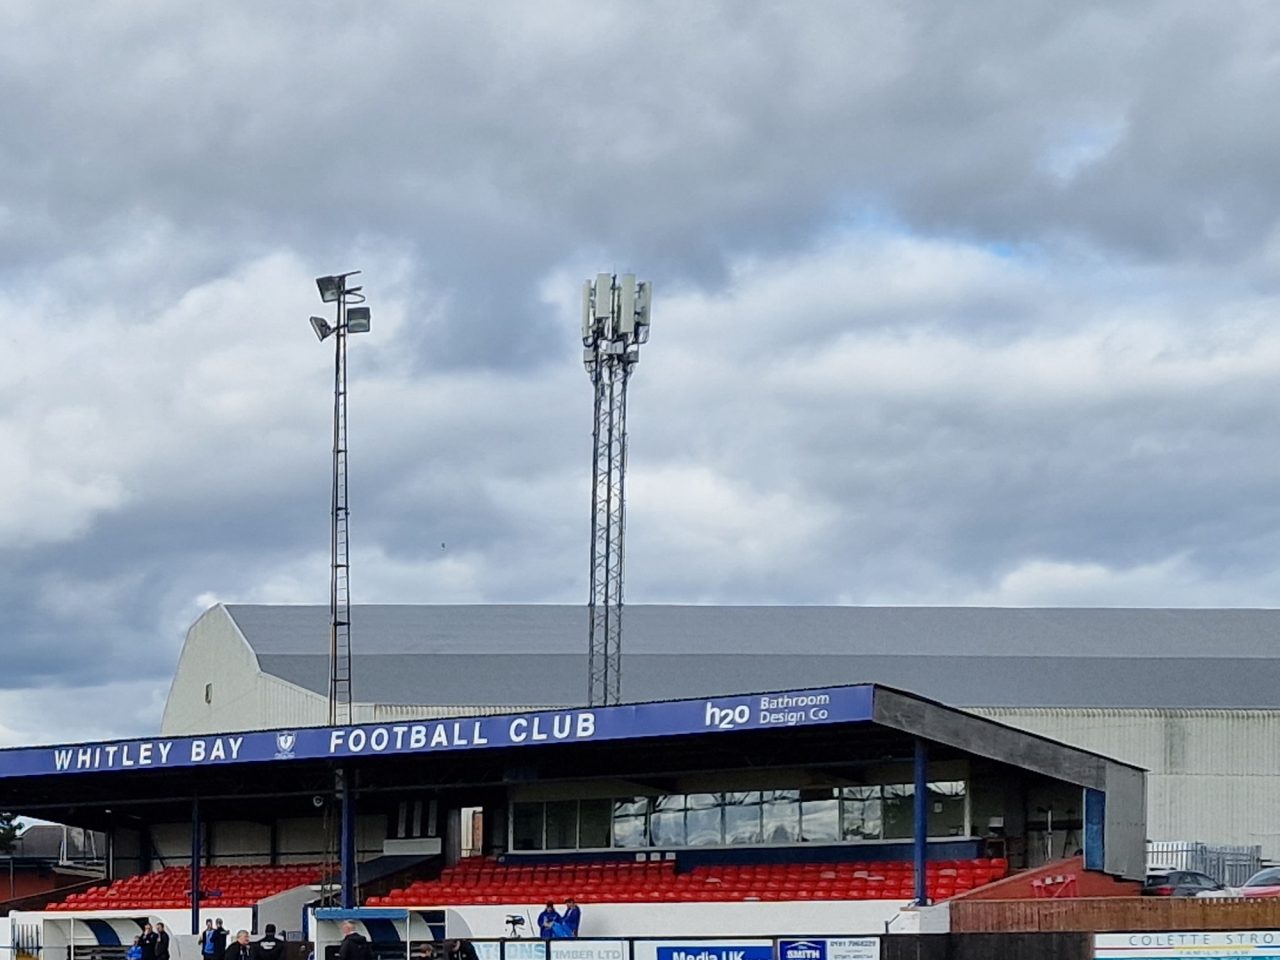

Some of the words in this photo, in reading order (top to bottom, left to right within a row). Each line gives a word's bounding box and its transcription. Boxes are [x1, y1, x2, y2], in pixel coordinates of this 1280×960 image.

[760, 694, 830, 710] Bathroom
[759, 709, 805, 725] Design
[809, 707, 828, 720] Co
[329, 721, 488, 753] FOOTBALL
[509, 712, 596, 743] CLUB
[54, 741, 173, 771] WHITLEY
[191, 737, 243, 762] BAY
[1129, 934, 1211, 946] COLETTE
[1226, 933, 1274, 945] STRO
[598, 949, 620, 960] LTD
